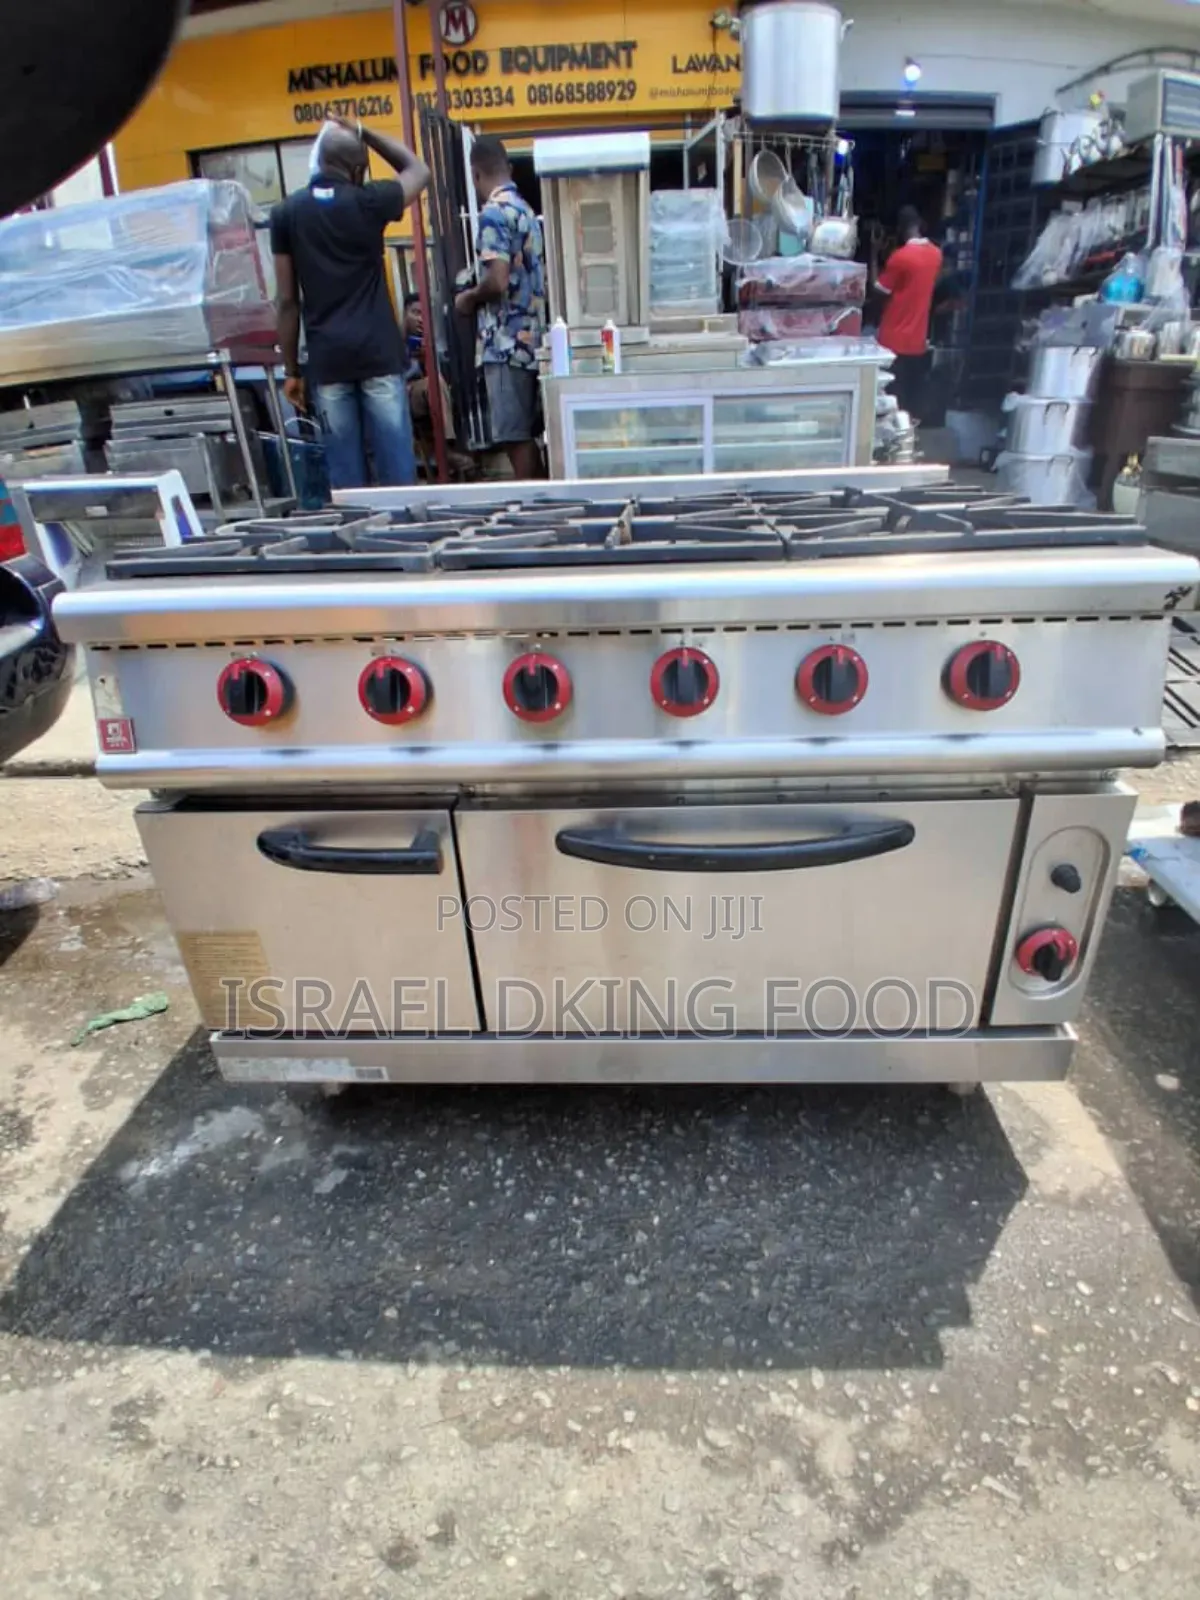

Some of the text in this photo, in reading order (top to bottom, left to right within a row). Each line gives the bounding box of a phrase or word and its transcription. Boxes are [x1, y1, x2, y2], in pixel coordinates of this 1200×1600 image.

[419, 50, 489, 80] FOOD
[499, 40, 637, 74] EQUIPMENT
[527, 80, 637, 106] 08168588929
